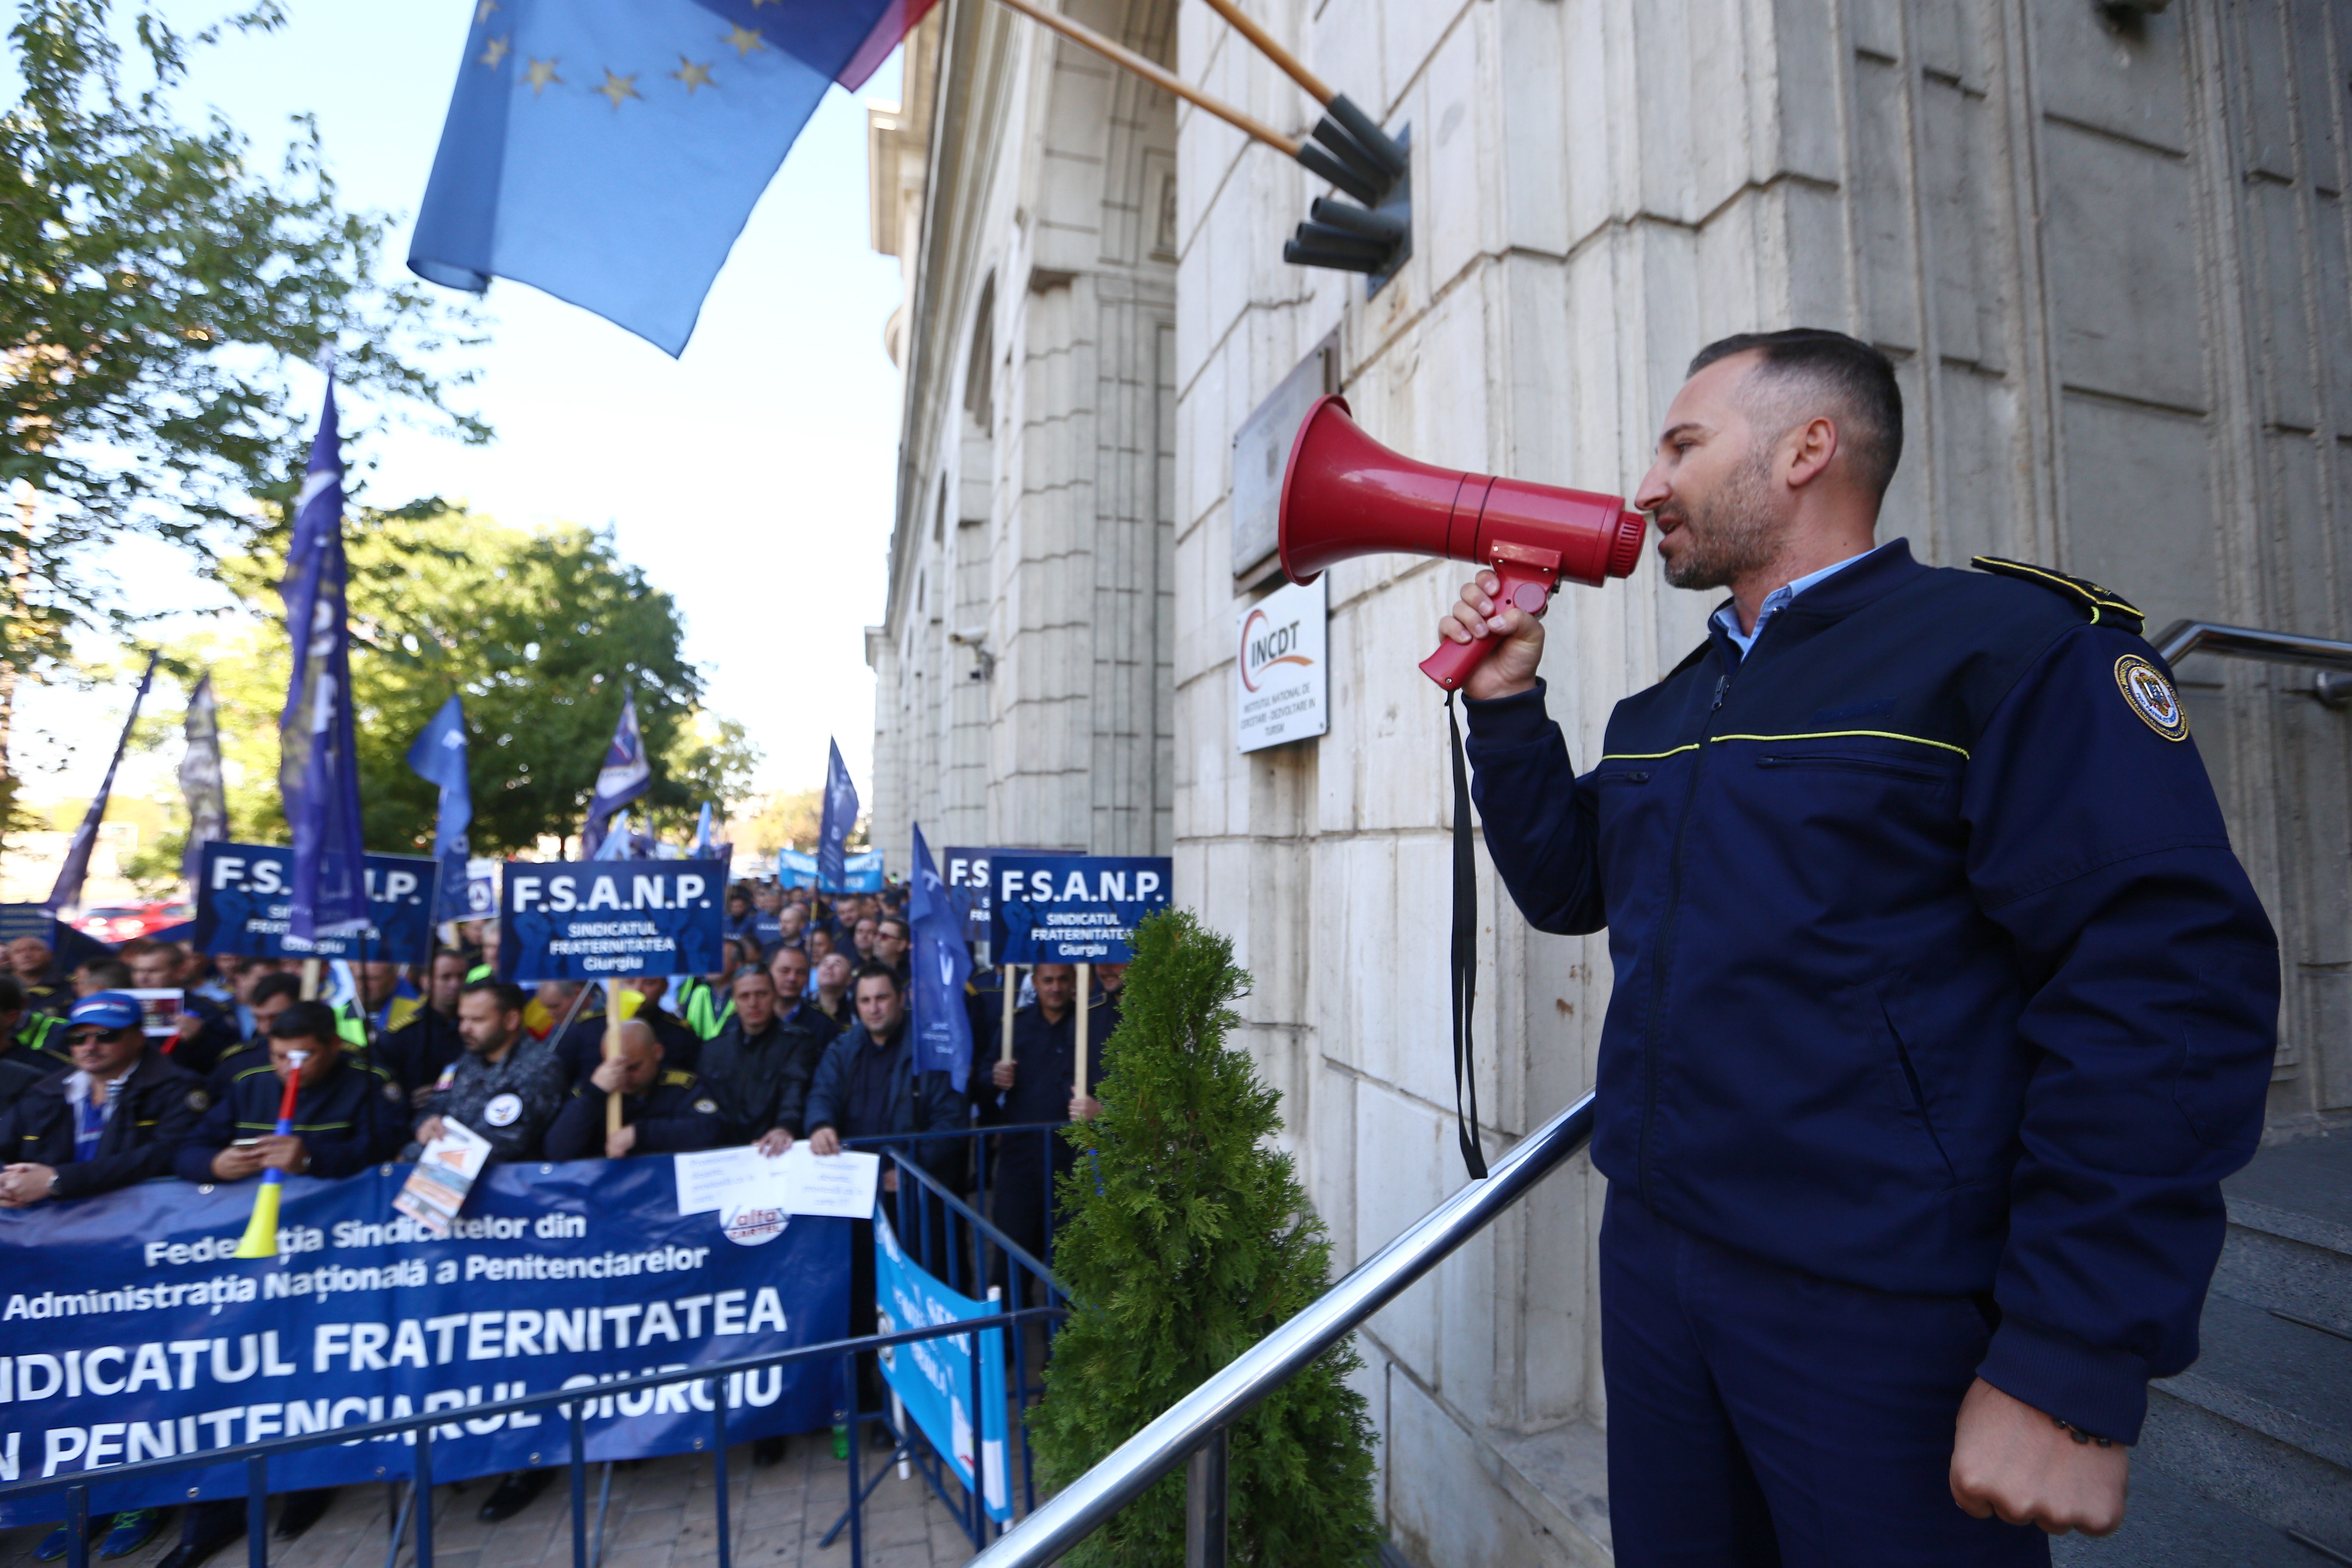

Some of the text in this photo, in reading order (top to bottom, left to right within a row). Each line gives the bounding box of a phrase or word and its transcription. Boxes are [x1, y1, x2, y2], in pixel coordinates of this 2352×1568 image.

[1251, 619, 1300, 667] INCDT
[512, 873, 712, 914] F.S.A.N.P.
[1001, 869, 1165, 903] F.S.A.N.P.
[567, 921, 659, 939] SINDICATUL
[1046, 912, 1121, 926] SINDICATUL
[549, 937, 677, 956] FRATERNITATEA
[1058, 942, 1108, 958] Giurgiu
[582, 956, 644, 973] Giurgiu
[144, 1224, 325, 1268] Fedeția
[534, 1212, 587, 1239] din
[2, 1244, 710, 1322] Administrația Națională a Penitenciarelor
[313, 1286, 788, 1373] FRATERNITATEA
